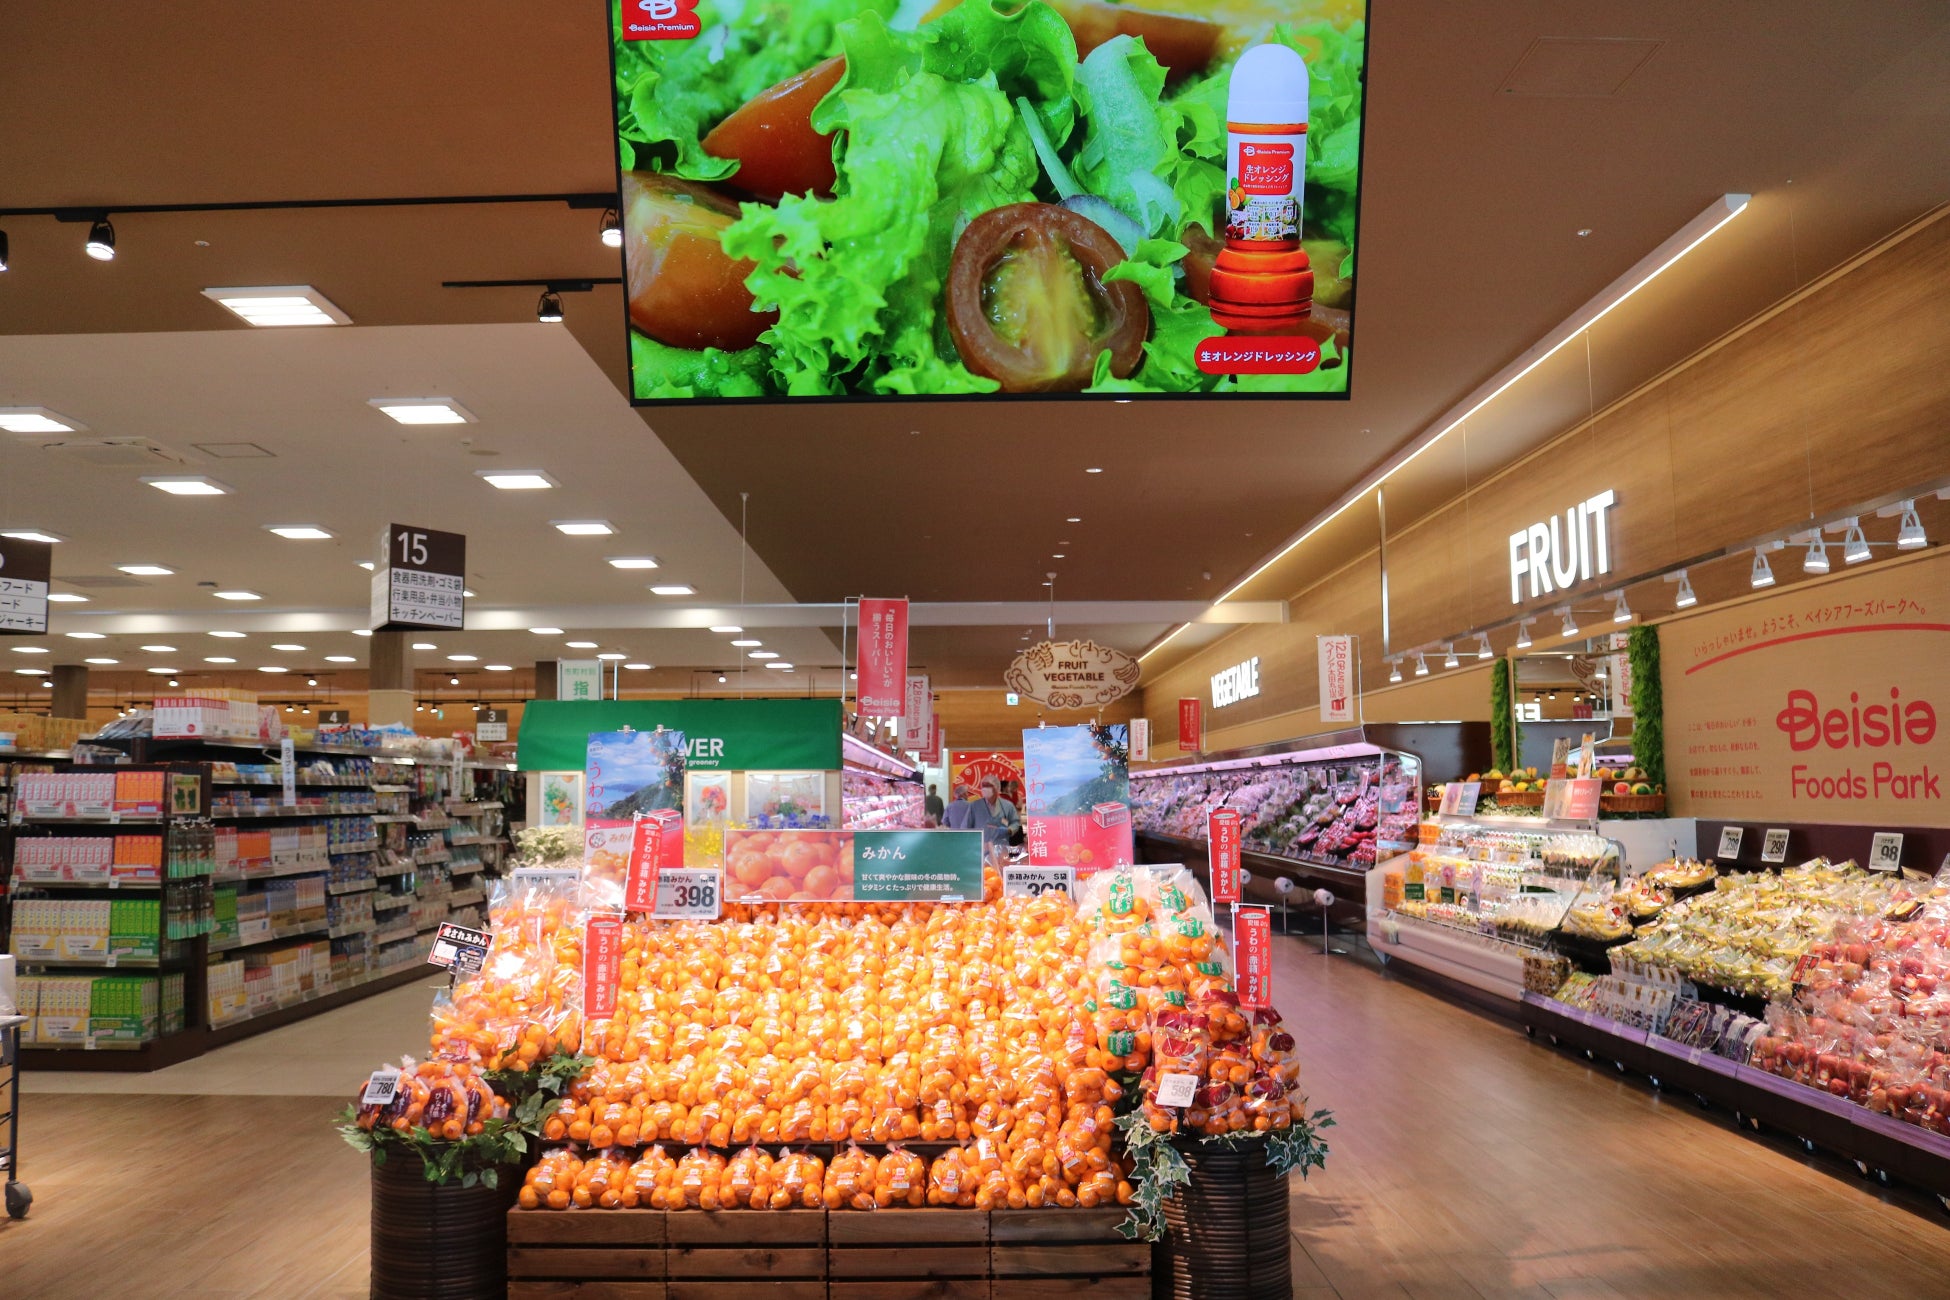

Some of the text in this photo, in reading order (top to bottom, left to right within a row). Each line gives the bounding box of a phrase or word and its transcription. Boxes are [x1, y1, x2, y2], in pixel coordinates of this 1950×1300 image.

[657, 23, 694, 31] Premium
[1246, 164, 1286, 174] 生オレンジ
[1244, 173, 1289, 183] ドレッシング
[1201, 351, 1316, 362] 生オレンジドレッシング
[397, 532, 428, 565] 15
[1509, 488, 1614, 605] FRUIT
[0, 581, 33, 594] フード
[392, 607, 461, 622] キッチンペーパー
[1058, 661, 1088, 670] FRUIT
[1043, 672, 1105, 681] VEGETABLE
[1211, 656, 1260, 709] VEGETABLE
[860, 695, 901, 707] Beisia
[329, 711, 338, 722] 4
[488, 711, 497, 722] 3
[1776, 686, 1937, 751] Beisia
[689, 759, 719, 767] greenery
[1791, 761, 1941, 799] Foods Park
[862, 846, 906, 860] みかん
[1770, 840, 1785, 854] 298
[1880, 845, 1899, 861] 98
[862, 873, 961, 881] 甘くて爽やかな酸味の冬の風物詩。
[1008, 873, 1046, 881] 赤箱みかん
[674, 885, 715, 908] 398
[376, 1082, 394, 1095] 780
[1171, 1084, 1191, 1097] 598
